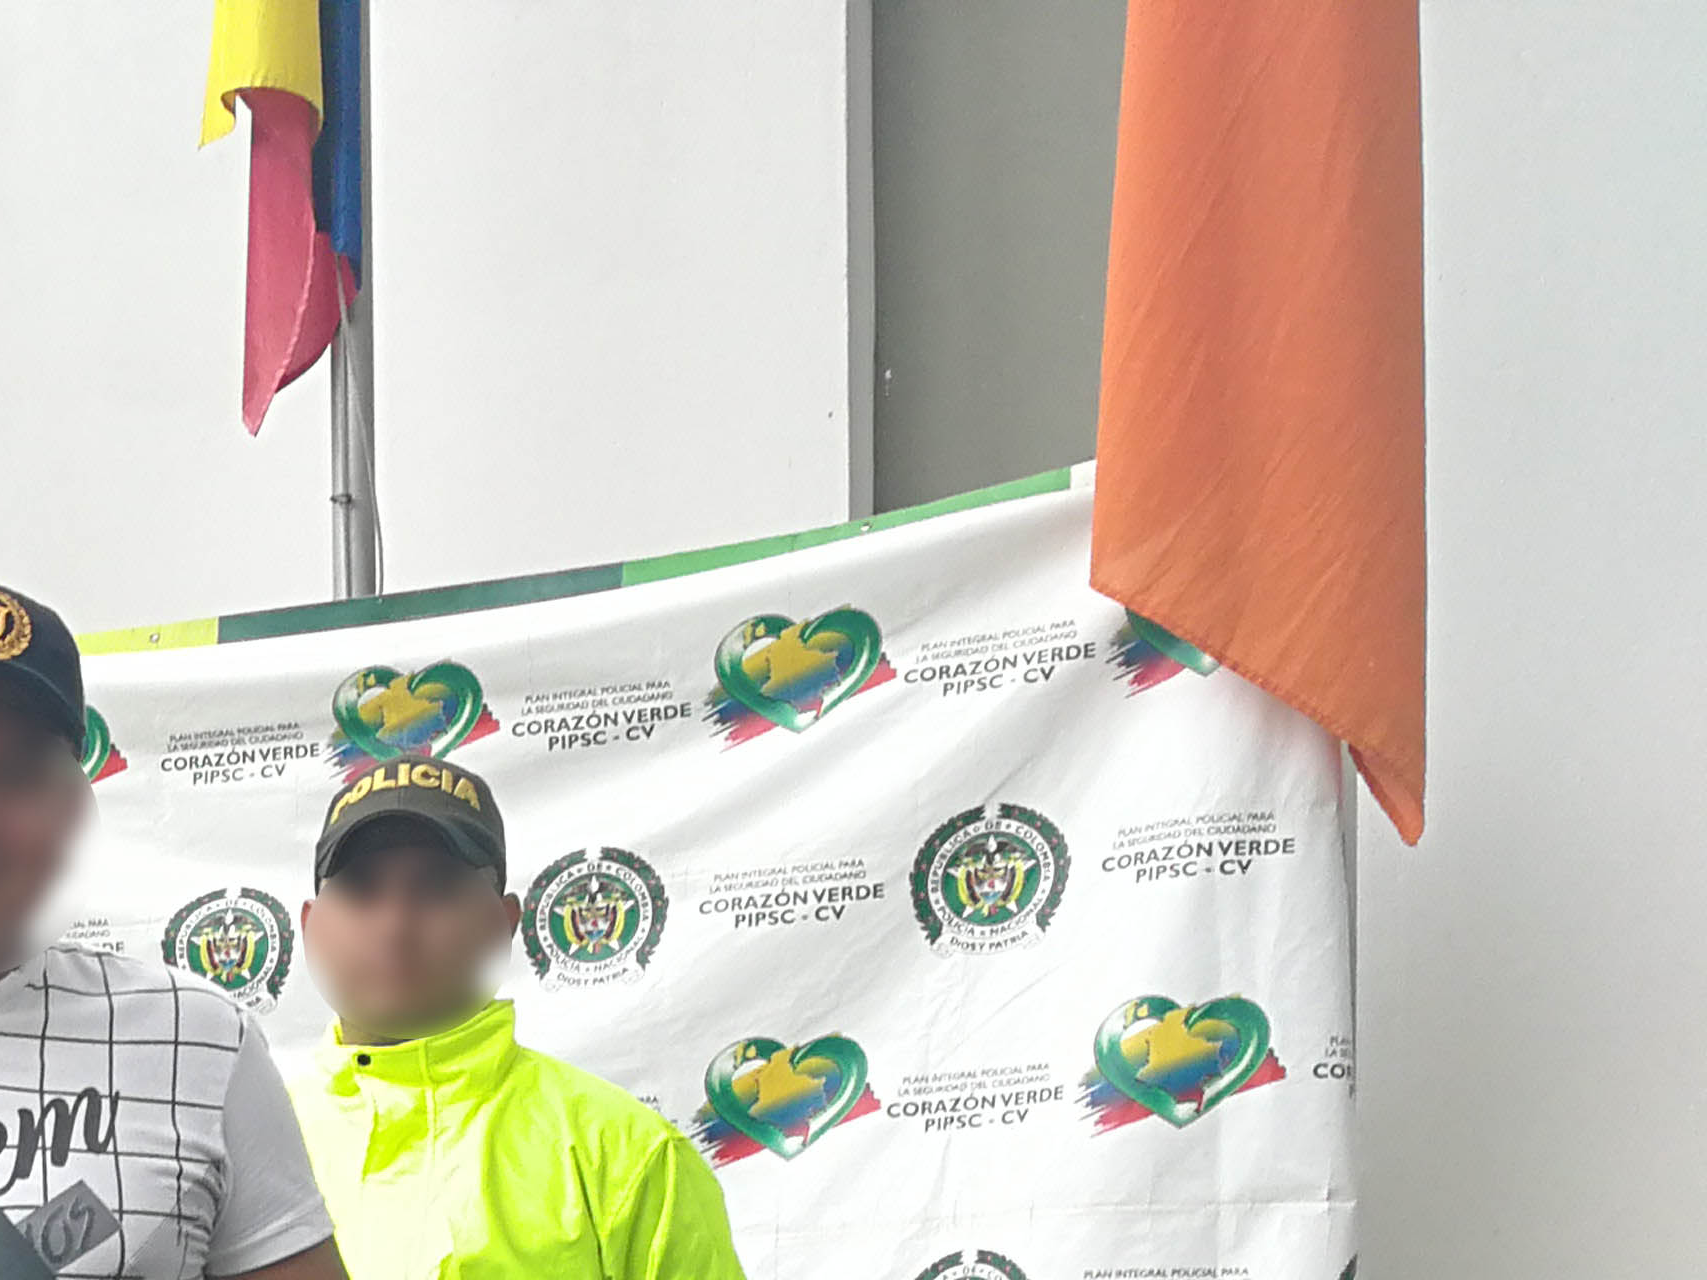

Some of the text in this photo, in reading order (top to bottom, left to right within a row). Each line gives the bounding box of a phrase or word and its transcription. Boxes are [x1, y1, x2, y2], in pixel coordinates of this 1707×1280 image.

[904, 642, 1096, 684] CORAZÓN VERDE
[943, 674, 1004, 696] PIPSC
[1024, 666, 1055, 683] CV
[512, 702, 691, 737] CORAZÓN VERDE
[548, 731, 607, 751] PIPSC
[626, 724, 655, 741] CV
[161, 743, 320, 772] CORAZÓN VERDE
[194, 768, 244, 785] PIPSC
[261, 764, 285, 778] CV
[330, 763, 480, 825] POLICIA
[1015, 825, 1051, 882] COLOMBIA
[1102, 838, 1296, 872] CORAZÓN VERDE
[1136, 861, 1198, 883] PIPSC
[1220, 859, 1252, 874] CV
[587, 863, 603, 872] DE
[616, 867, 649, 920] COLOMBIA
[699, 883, 885, 915] CORAZÓN VERDE
[735, 909, 795, 928] PIPSC
[815, 905, 845, 921] CV
[938, 898, 1042, 936] POLICIA NACIONAL
[950, 937, 976, 950] DIOS
[988, 931, 1028, 949] PATRIA
[887, 1084, 1064, 1118] CORAZÓN VERDE
[925, 1113, 983, 1132] PIPSC
[1001, 1108, 1028, 1124] CV
